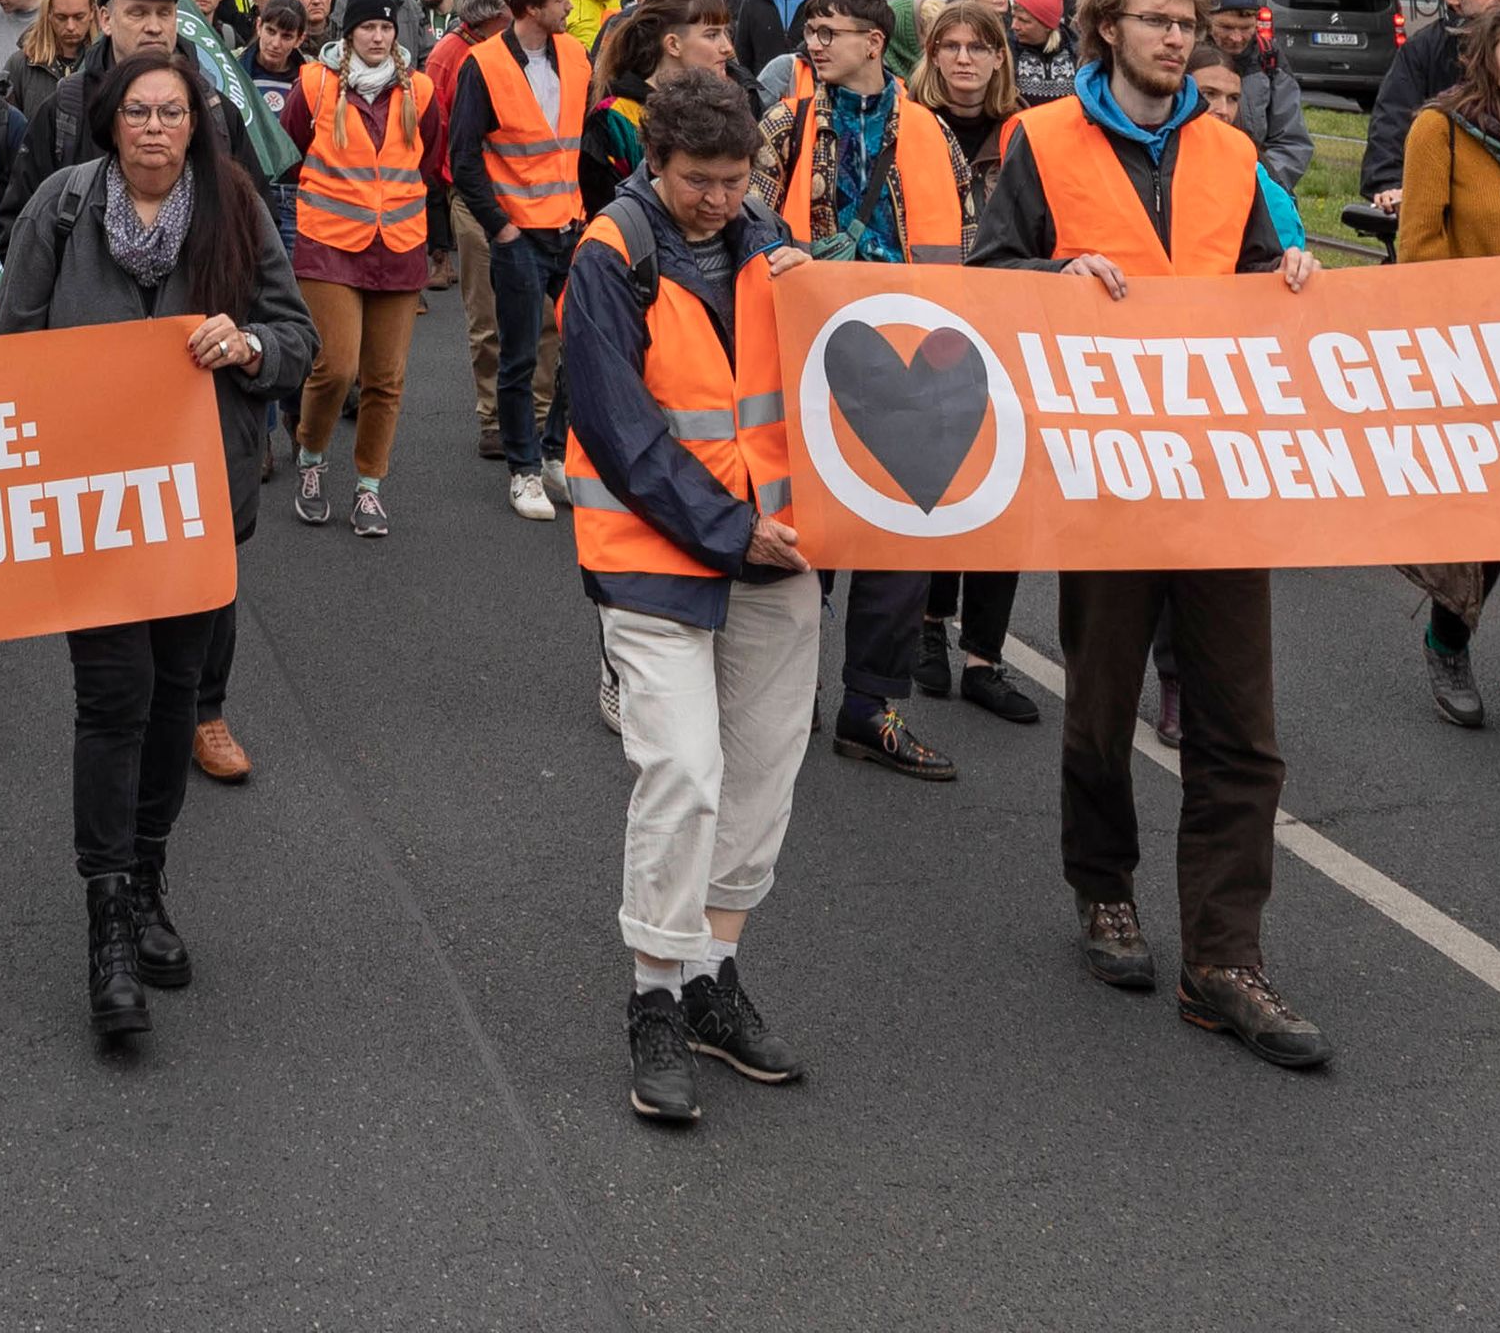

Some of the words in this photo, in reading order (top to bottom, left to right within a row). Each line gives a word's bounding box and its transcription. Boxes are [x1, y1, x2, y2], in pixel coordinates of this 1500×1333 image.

[1016, 332, 1306, 416] LETZTE
[1040, 427, 1203, 501] VOR
[1208, 427, 1366, 499] DEN
